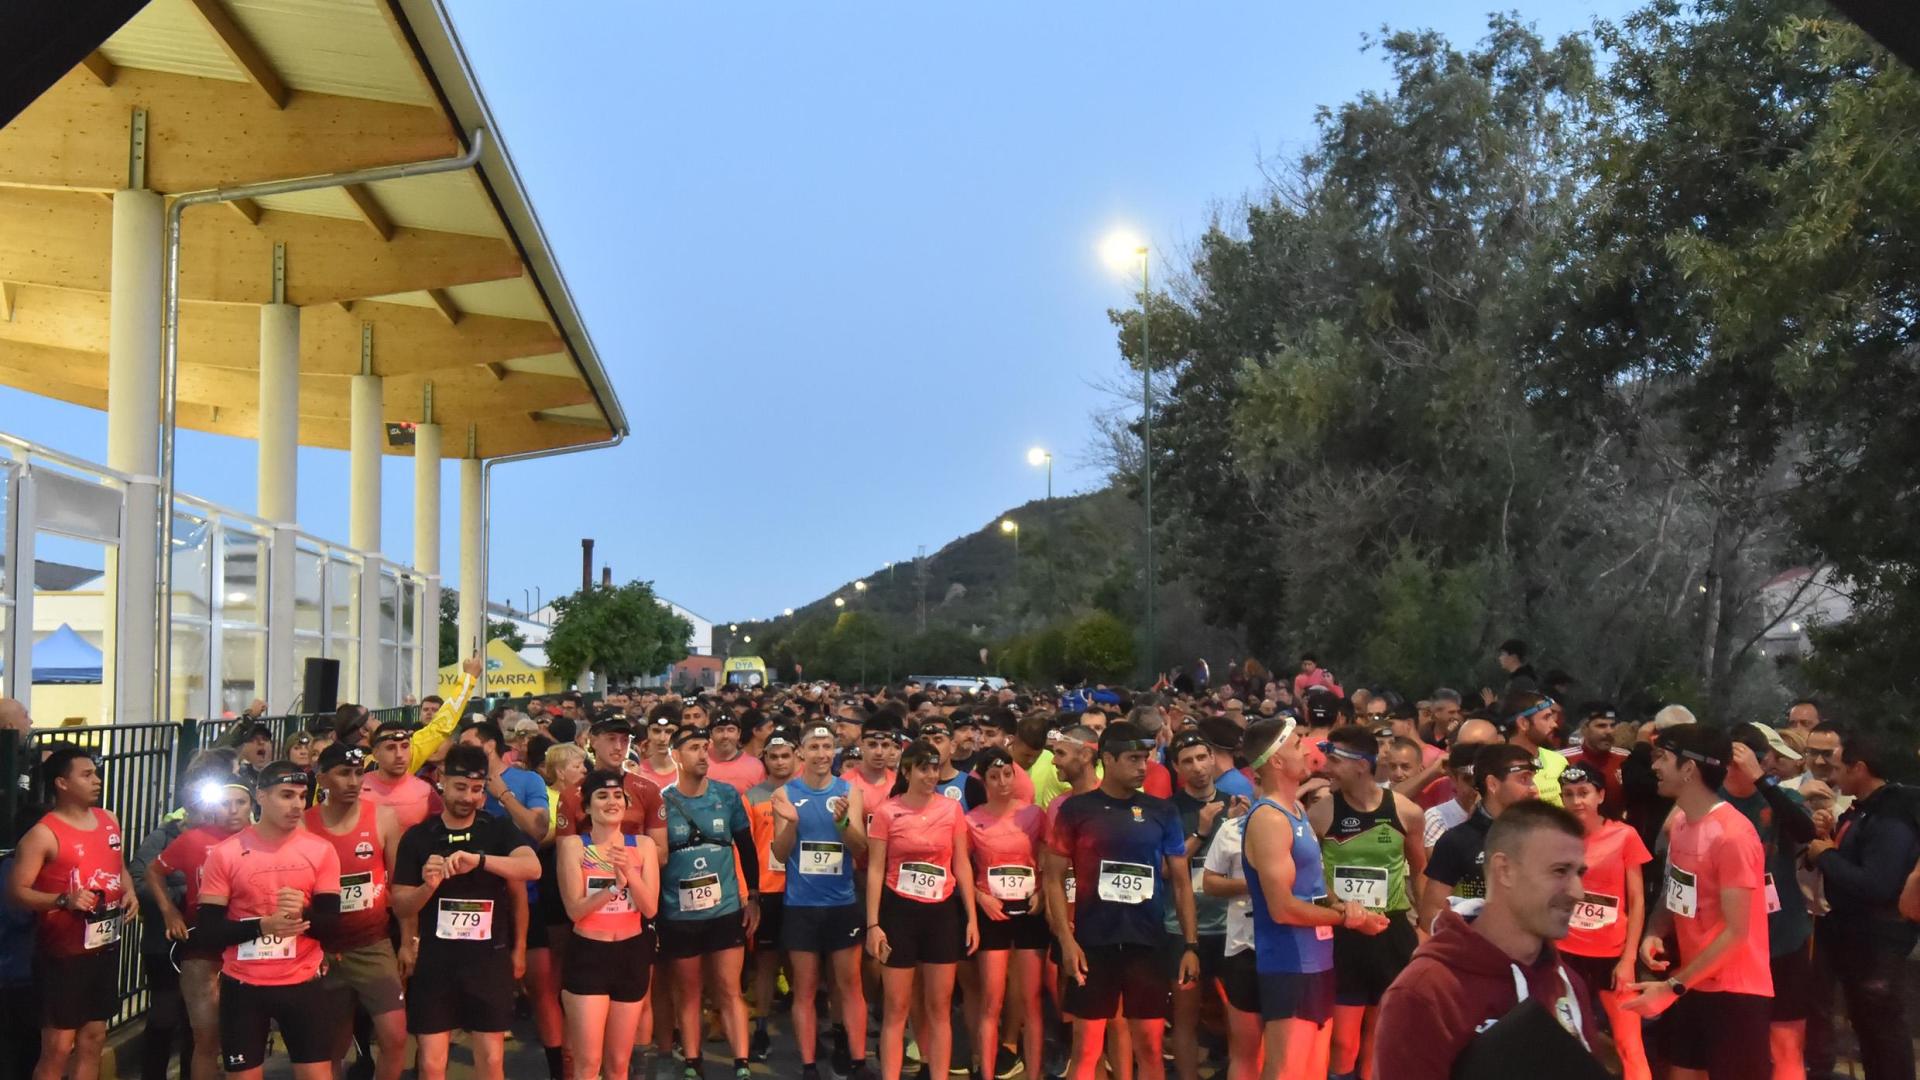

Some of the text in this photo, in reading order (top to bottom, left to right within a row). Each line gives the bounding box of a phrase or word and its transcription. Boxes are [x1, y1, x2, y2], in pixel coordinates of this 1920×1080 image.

[735, 661, 753, 670] DYA
[814, 852, 831, 864] 97
[911, 873, 936, 887] 136
[1000, 876, 1025, 888] 137
[1112, 875, 1142, 891] 495
[1344, 879, 1375, 894] 377
[688, 886, 712, 900] 126
[1577, 902, 1605, 919] 764
[451, 912, 481, 927] 779
